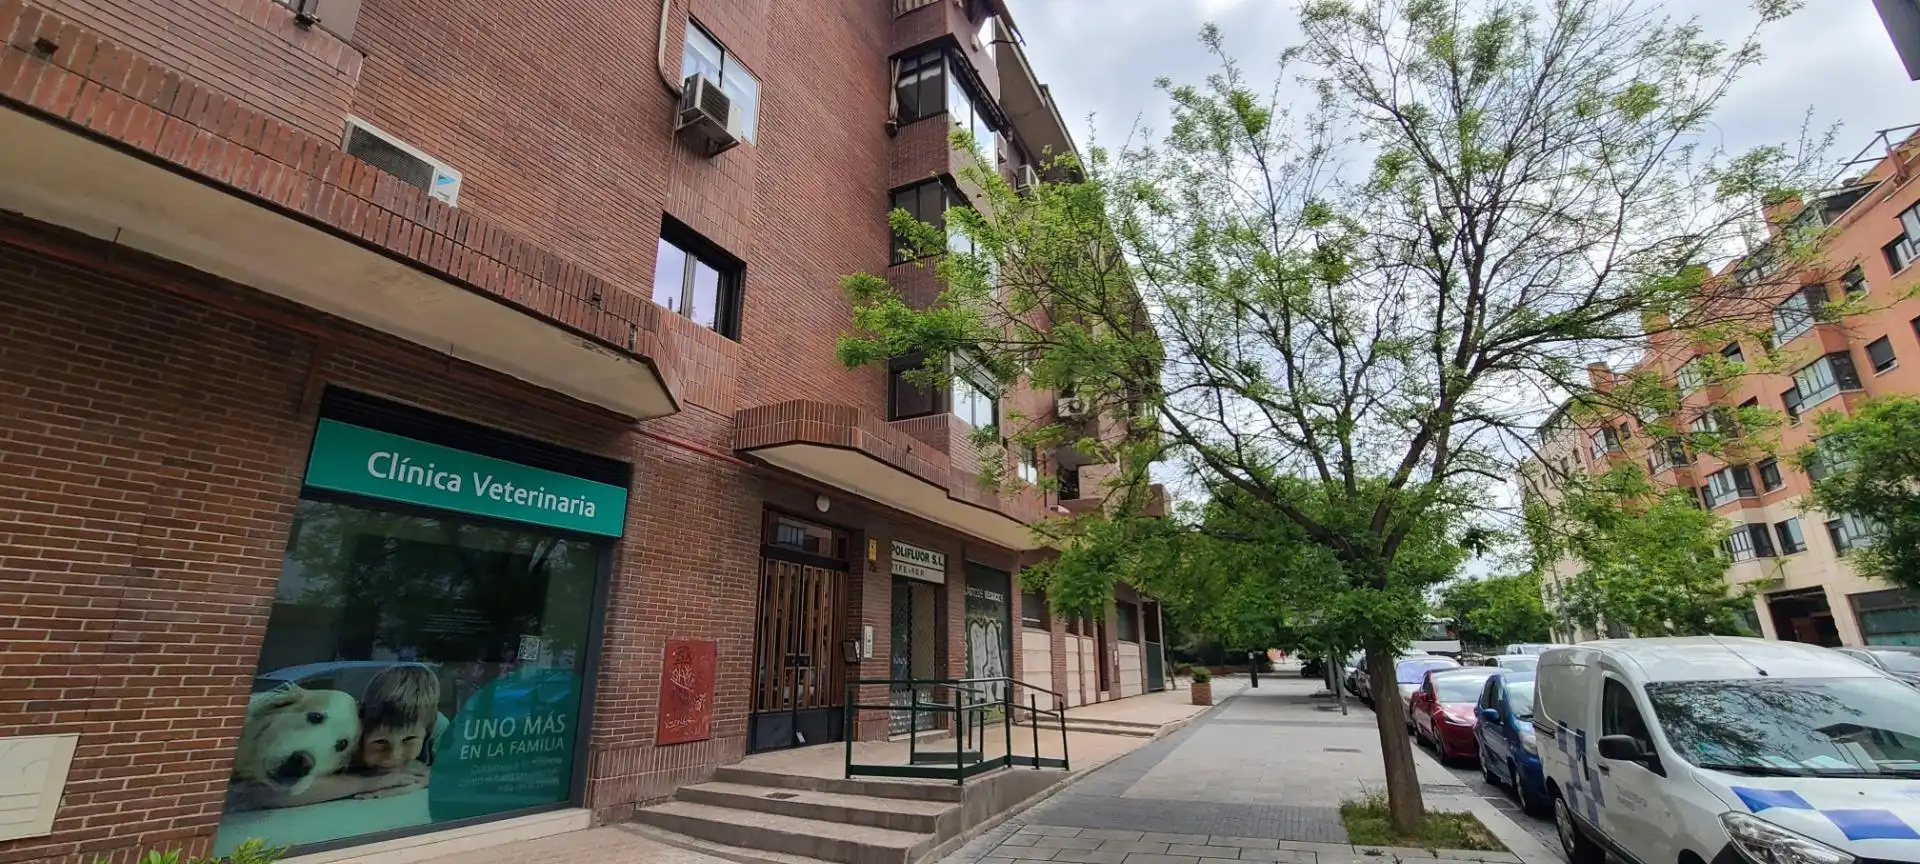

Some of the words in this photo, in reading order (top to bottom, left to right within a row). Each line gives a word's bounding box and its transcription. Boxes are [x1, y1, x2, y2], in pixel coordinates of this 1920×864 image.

[367, 450, 463, 493] Clínica
[472, 471, 596, 518] Veterinaria
[463, 717, 516, 740] UNO
[523, 710, 567, 736] MÁS
[460, 743, 482, 760] EN
[487, 741, 504, 758] LA
[509, 737, 565, 756] FAMILIA
